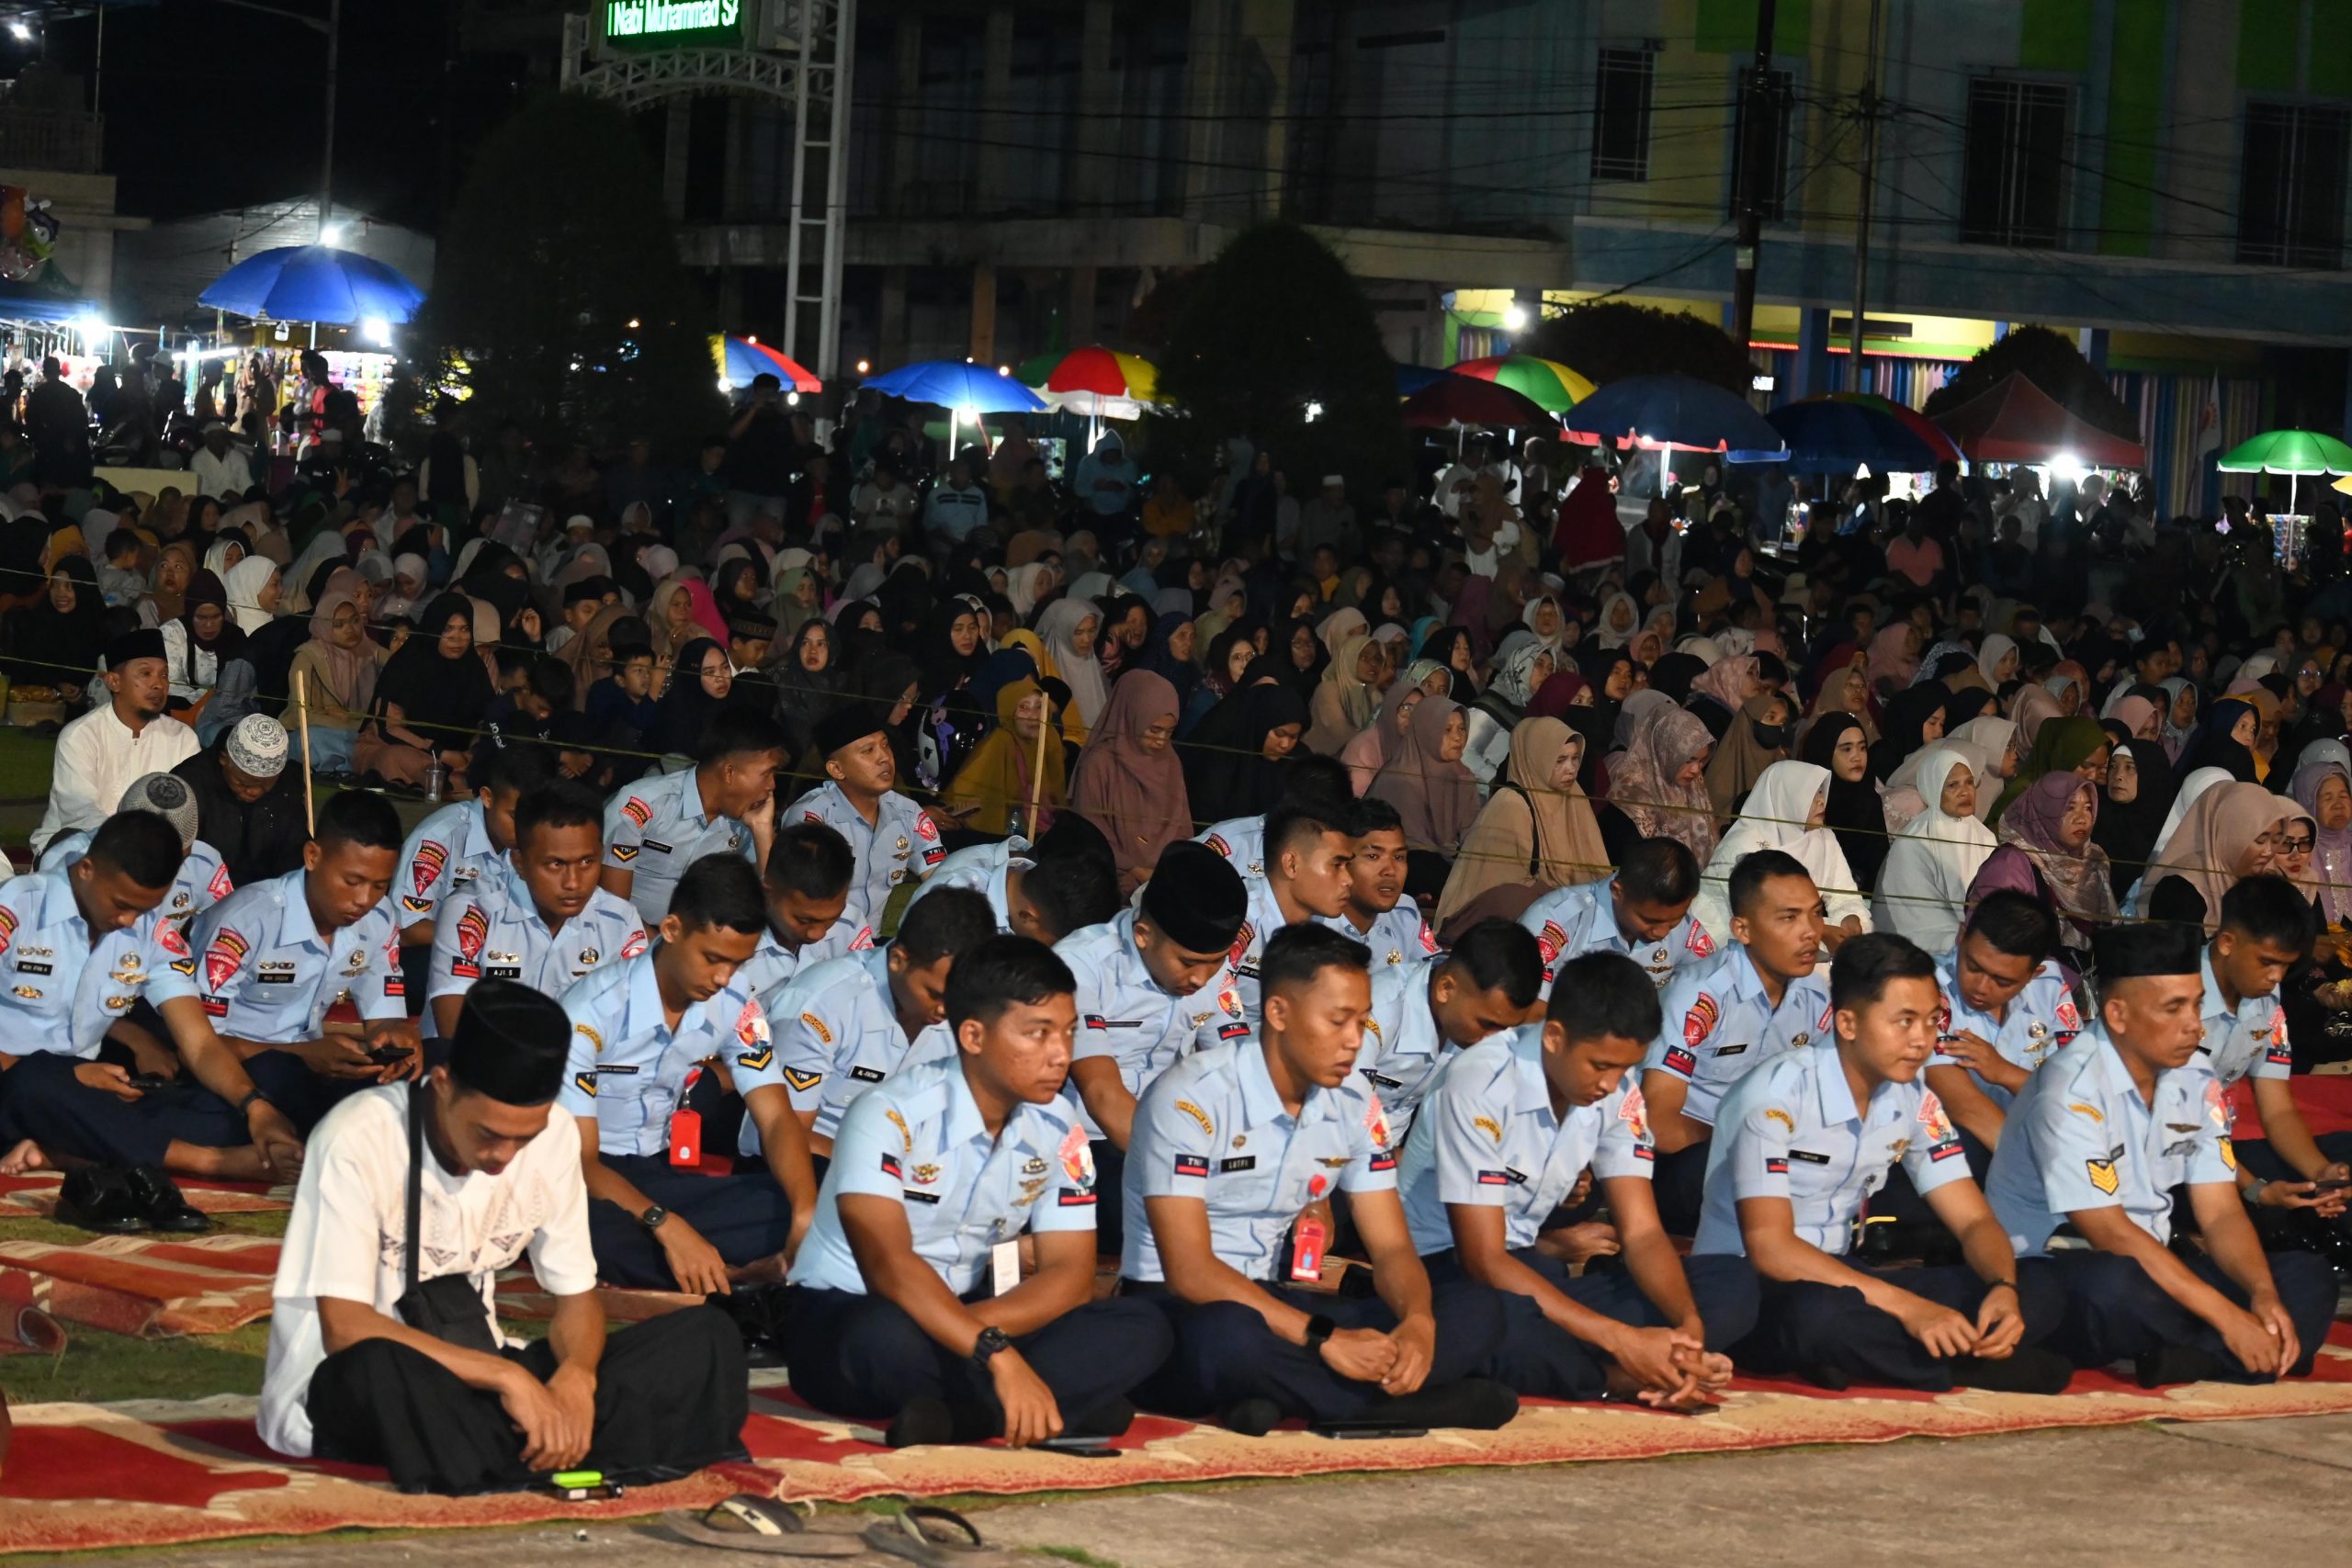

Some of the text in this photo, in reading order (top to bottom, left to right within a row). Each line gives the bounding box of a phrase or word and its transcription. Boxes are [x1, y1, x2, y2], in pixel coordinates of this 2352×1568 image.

[614, 0, 643, 36] Nabi
[644, 0, 719, 33] Muhammad
[423, 848, 443, 860] AIRBORNE
[424, 840, 447, 856] COMMANDOS
[220, 928, 249, 949] COMMANDOS
[220, 937, 243, 953] AIRBORNE
[205, 996, 220, 1005] TNI
[804, 1014, 831, 1042] INDONESIA
[1677, 1050, 1693, 1062] TNI
[797, 1071, 809, 1080] TNI
[1188, 1157, 1204, 1166] TNI
